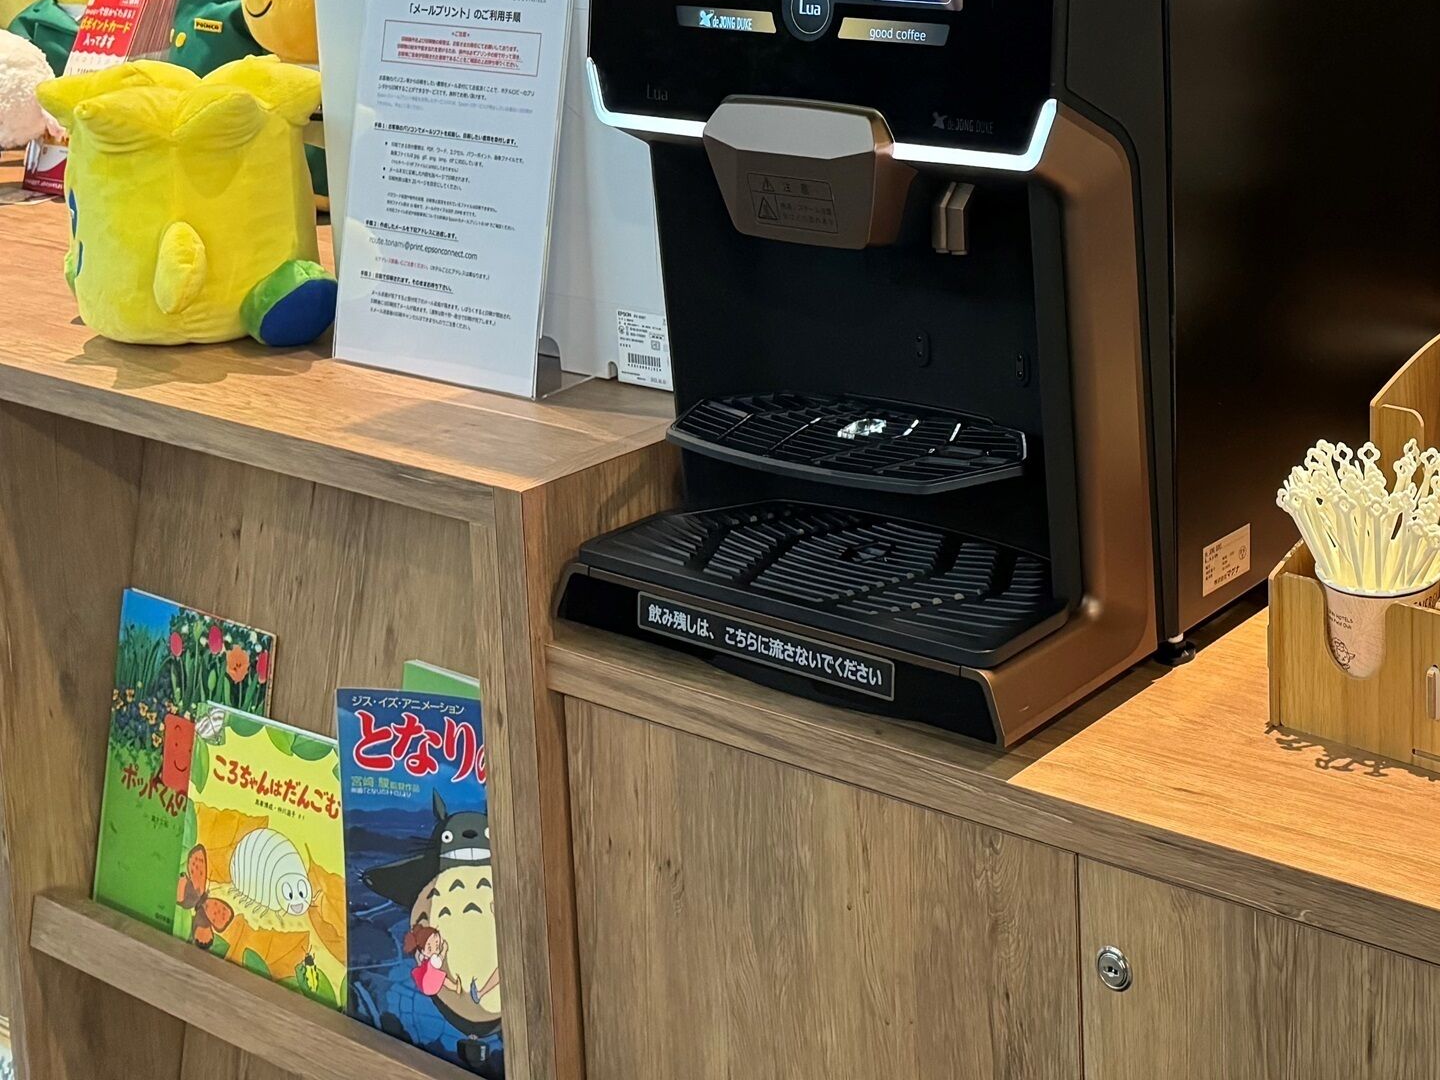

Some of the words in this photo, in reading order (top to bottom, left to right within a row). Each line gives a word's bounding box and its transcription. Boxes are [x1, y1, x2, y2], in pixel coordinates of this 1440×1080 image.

[409, 2, 522, 23] 「メールプリント」のご利用手順
[869, 27, 893, 41] good
[896, 29, 926, 42] coffee
[648, 603, 883, 686] 飲み残しは、こちらに流さないでください
[351, 695, 466, 715] ジス・イズ・アニメーション
[213, 754, 342, 820] ころちゃんはだんごむ
